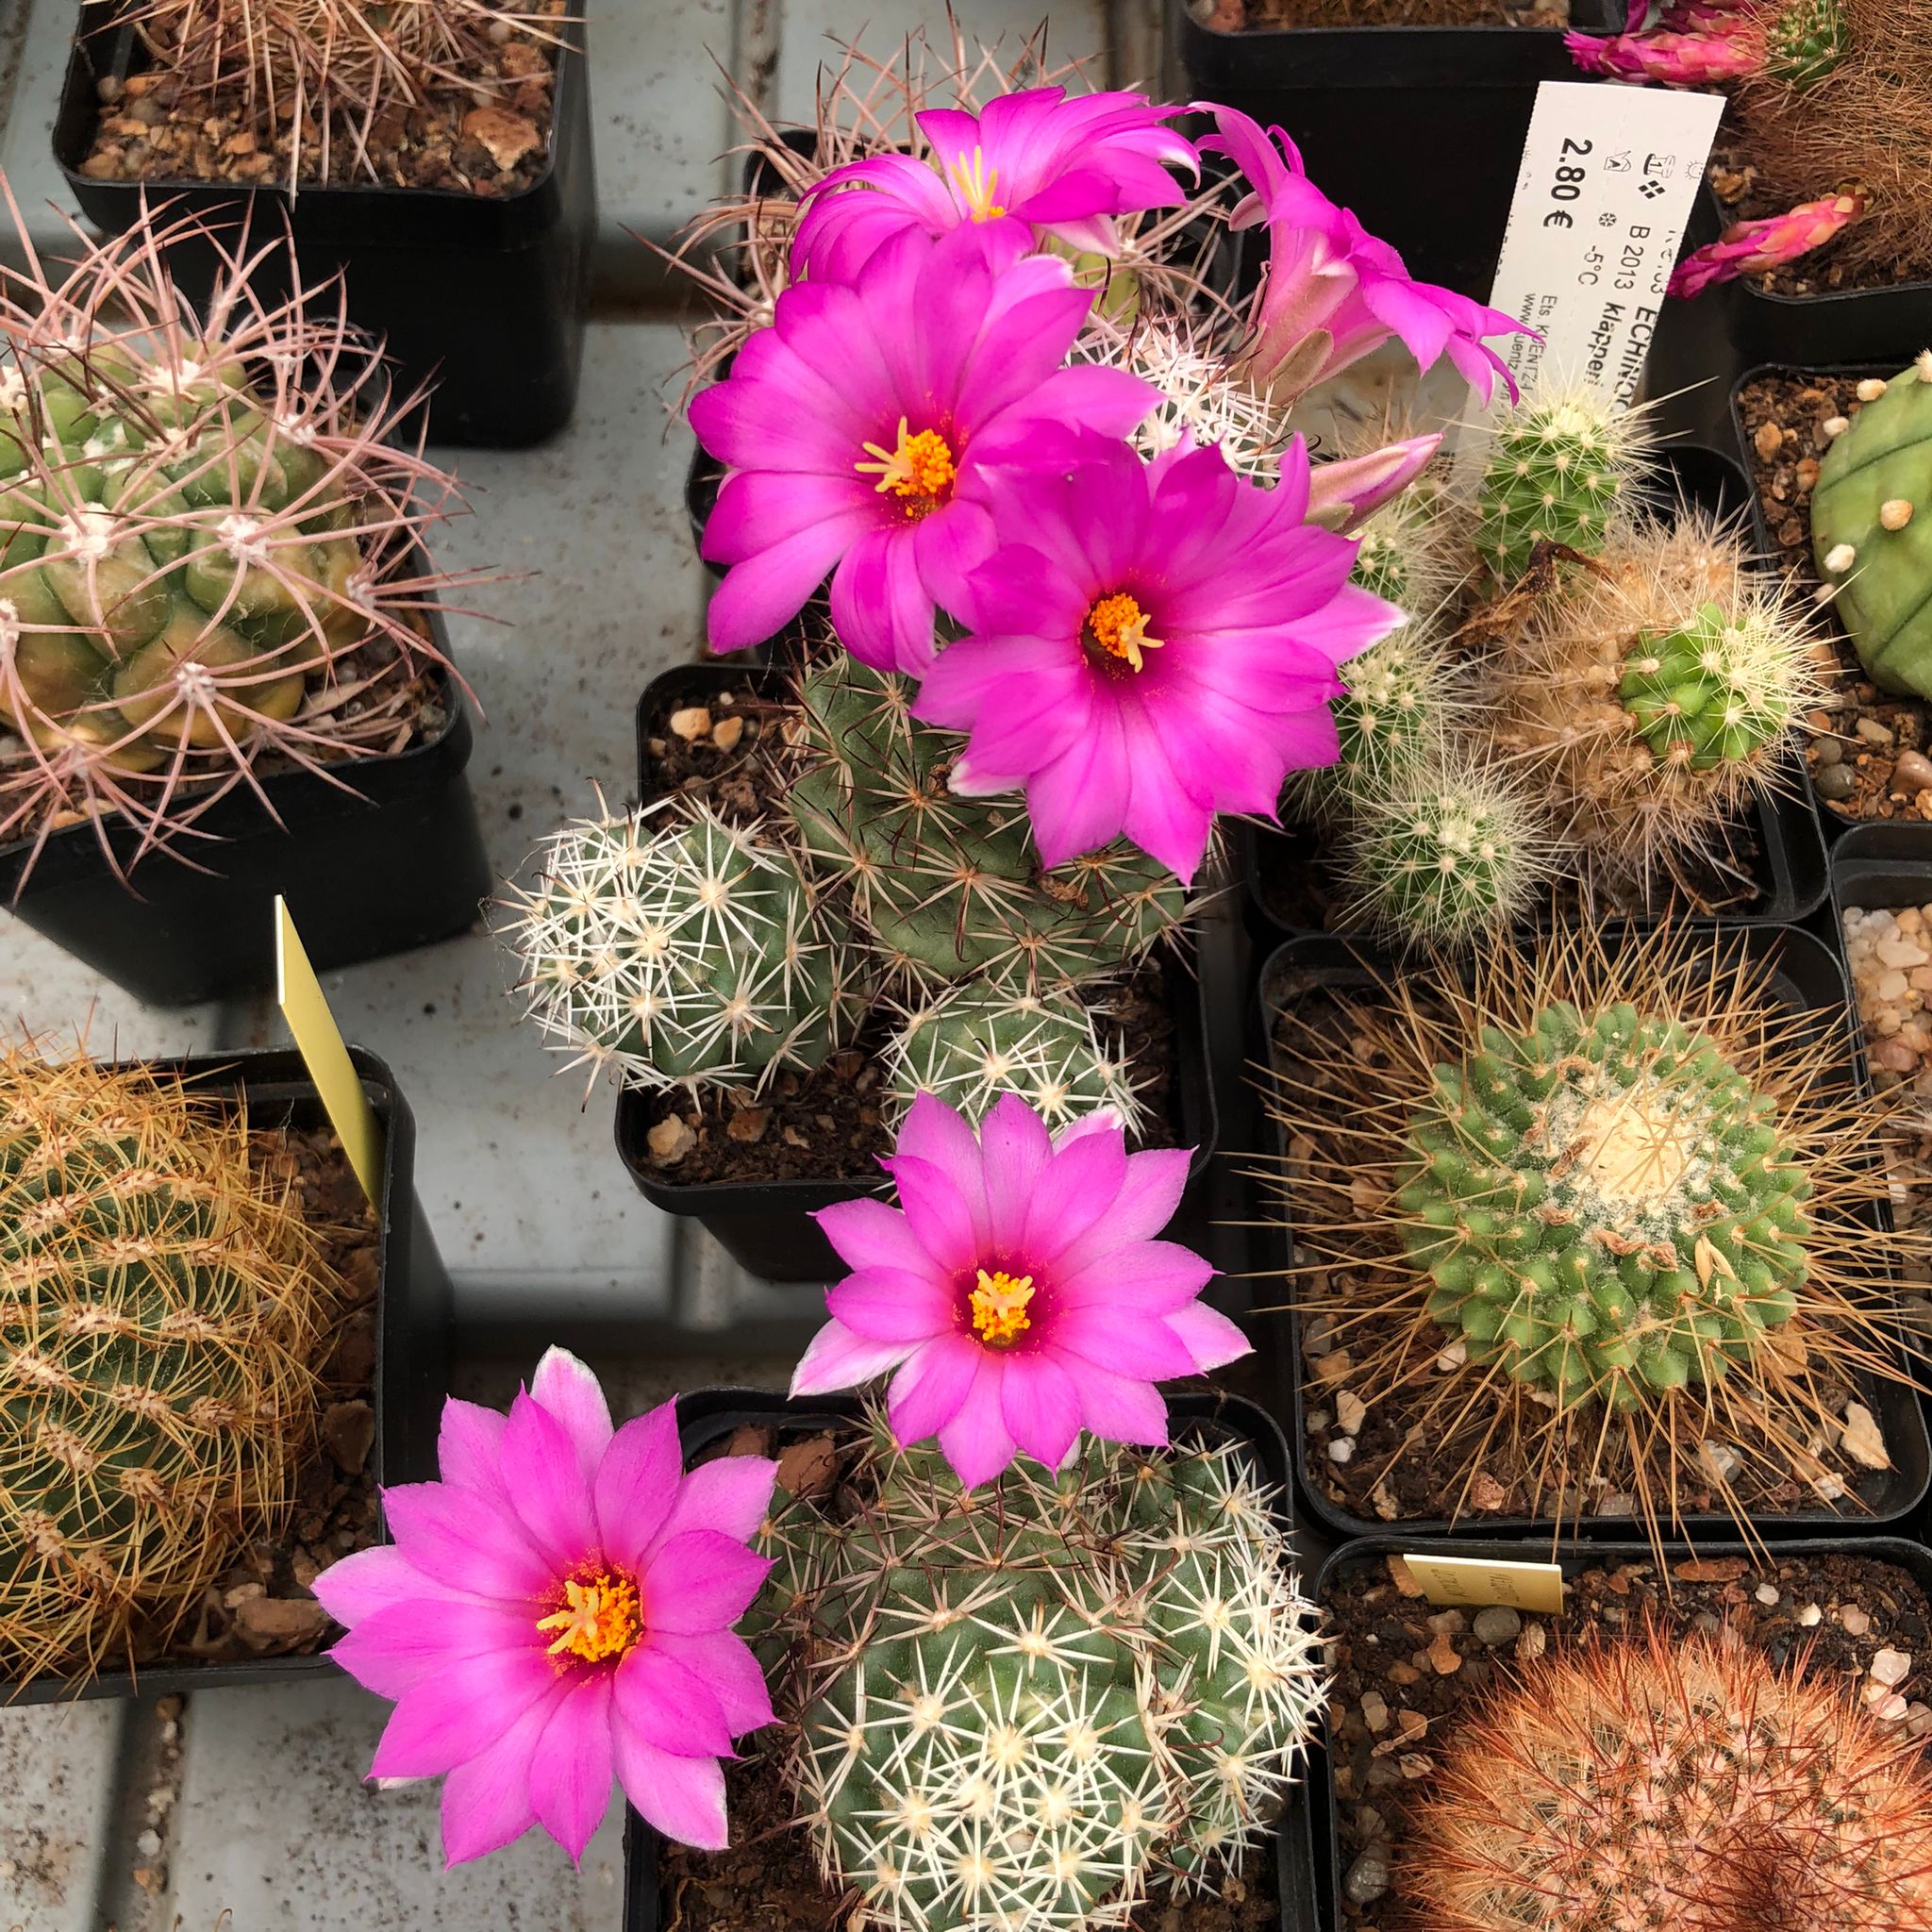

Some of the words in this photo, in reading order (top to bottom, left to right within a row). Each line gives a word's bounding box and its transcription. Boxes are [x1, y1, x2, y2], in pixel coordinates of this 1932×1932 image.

[1551, 138, 1593, 201] 2.80
[1543, 209, 1574, 229] €
[1629, 225, 1651, 239] B
[1578, 245, 1604, 286] -5°C
[1614, 244, 1644, 290] 2013
[1538, 295, 1557, 319] Ets.
